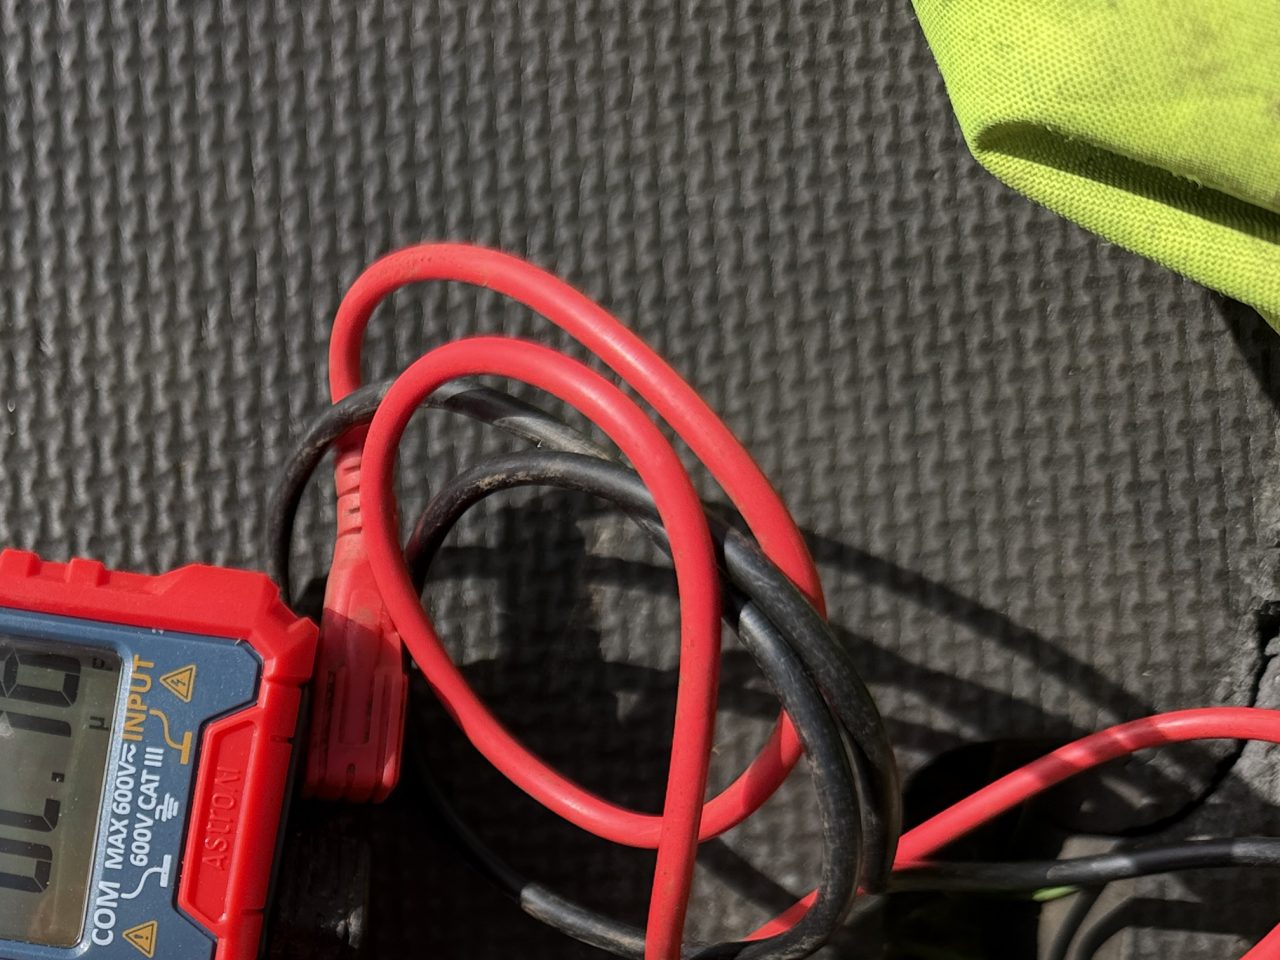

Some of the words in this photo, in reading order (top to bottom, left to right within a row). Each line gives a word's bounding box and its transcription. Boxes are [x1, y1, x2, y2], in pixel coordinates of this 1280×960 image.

[119, 653, 154, 742] INPUT
[137, 769, 161, 810] CAT
[203, 766, 239, 871] AstroAI
[106, 818, 130, 870] MAX
[130, 816, 155, 867] 600V
[92, 881, 122, 946] COM
